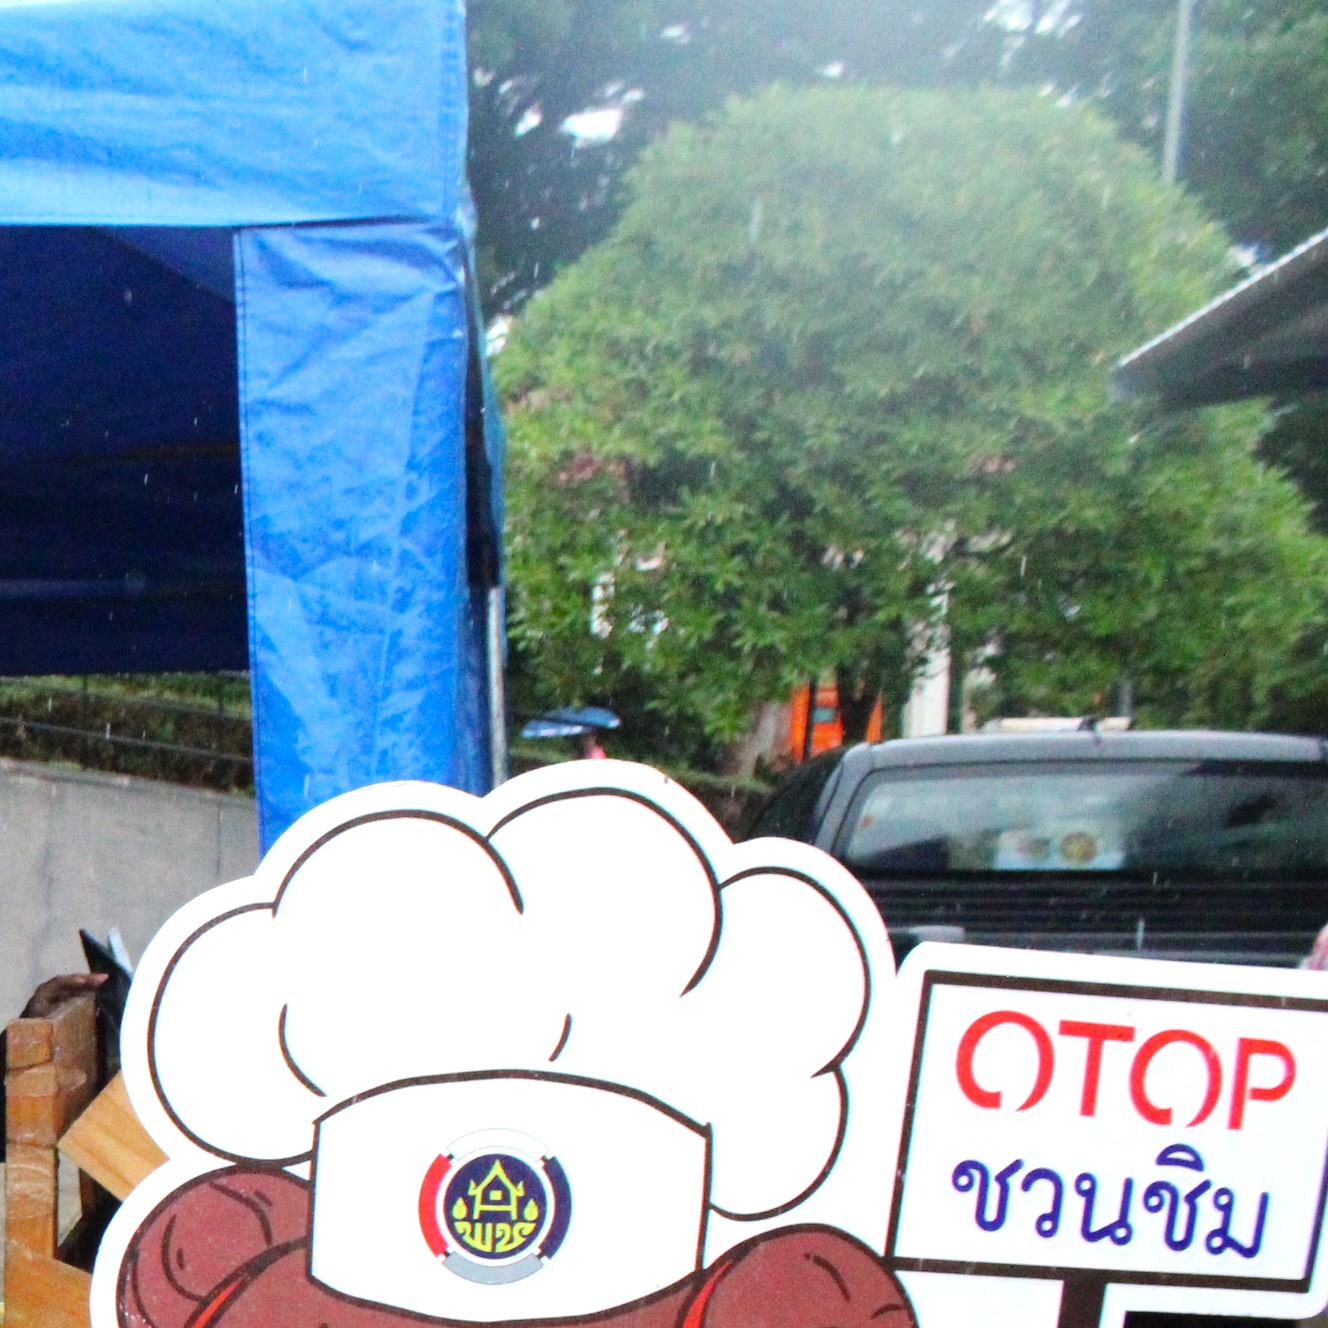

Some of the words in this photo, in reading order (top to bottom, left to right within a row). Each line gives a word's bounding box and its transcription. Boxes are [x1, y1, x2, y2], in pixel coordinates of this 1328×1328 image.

[954, 1008, 1297, 1131] OTOP
[951, 1143, 1270, 1260] ชวนชิม
